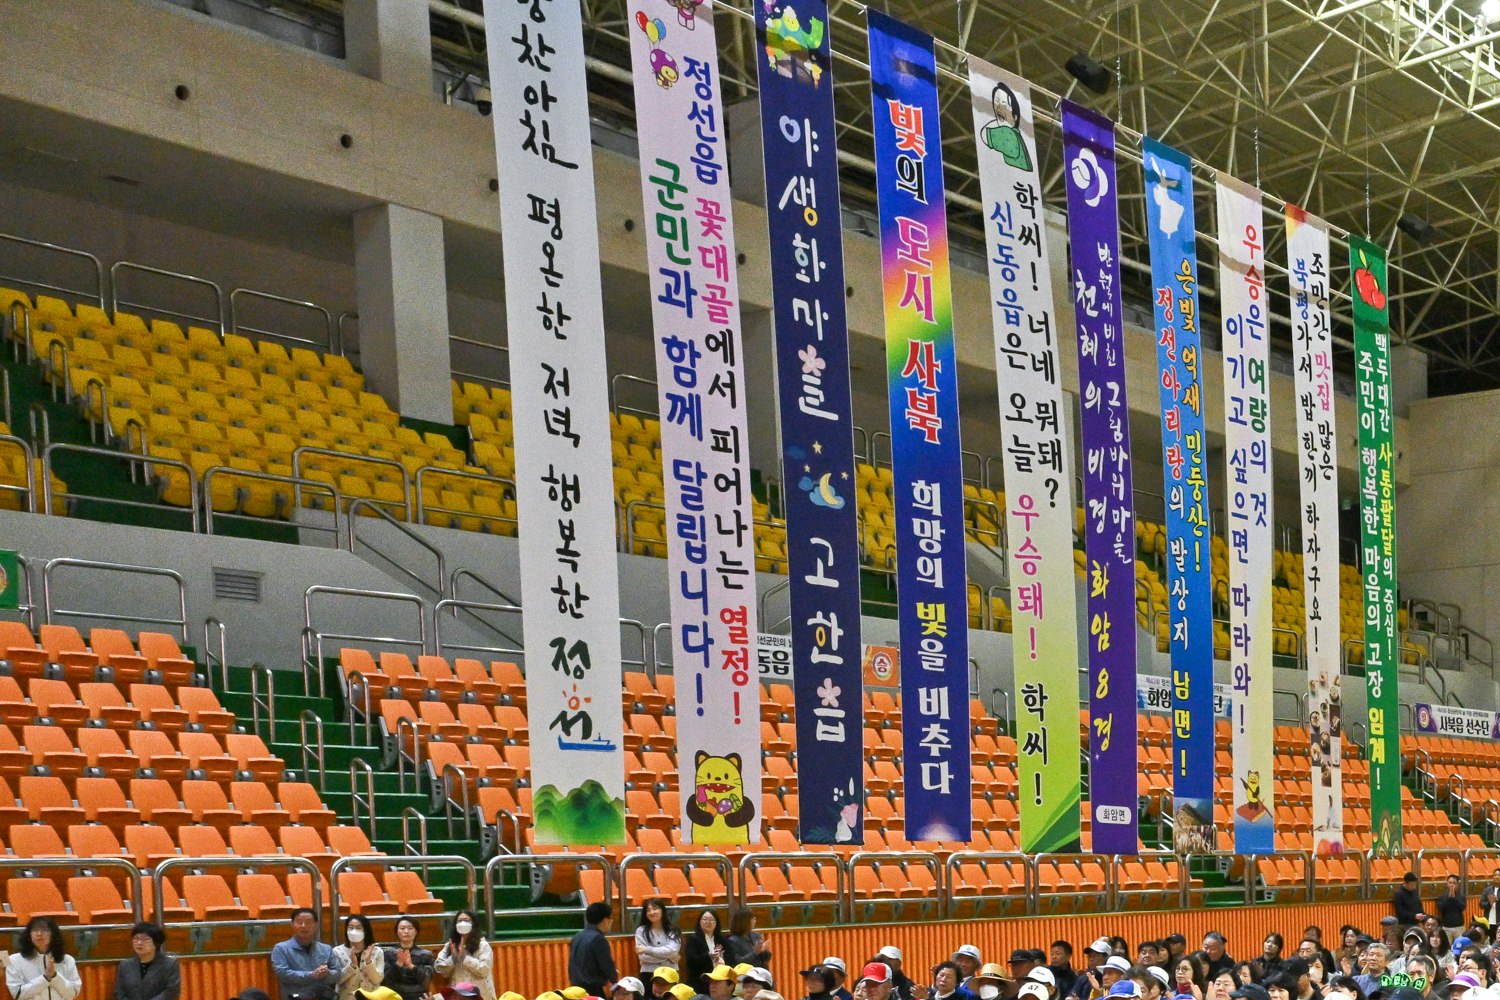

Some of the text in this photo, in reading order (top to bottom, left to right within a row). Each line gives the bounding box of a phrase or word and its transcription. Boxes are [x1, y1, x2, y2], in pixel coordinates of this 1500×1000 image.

[519, 80, 579, 169] 아침
[526, 193, 571, 341] 평온한
[1013, 181, 1063, 508] 학씨! 너네 뭐돼?
[1075, 269, 1101, 414] 천혜의
[540, 362, 582, 448] 저녁
[649, 158, 714, 717] 군민과 함께 달립니다!
[683, 56, 750, 725] 정선읍 꽃대골에서 피어나는 열정!
[887, 98, 955, 795] 빛의 도시 사북 희망의 빛을 비추다
[1156, 286, 1184, 520] 정선아리랑의
[1175, 259, 1208, 572] 은빛 억새 민둥산!
[1243, 224, 1267, 528] 우승은 여량의 것
[1314, 350, 1331, 412] 맛집
[1318, 420, 1334, 481] 많은
[990, 200, 1049, 807] 신동읍은 오늘 우승돼! 학씨!
[1087, 446, 1107, 534] 비경
[1226, 313, 1252, 734] 이기고 싶으면 따라와!
[1293, 258, 1313, 382] 북평가서
[1305, 502, 1322, 653] 하자구요!
[1375, 333, 1396, 660] 백두대간 사통팔달의 중심!
[541, 464, 589, 619] 행복한
[1169, 537, 1189, 651] 발상지
[1358, 351, 1386, 790] 주민이 행복한 마음의 고장 임계!
[549, 636, 617, 751] 정선
[757, 635, 786, 647] 선군민의
[804, 538, 845, 743] 고한읍
[876, 658, 888, 673] 승
[1440, 716, 1489, 736] 사북읍 선수단
[1102, 808, 1125, 822] 화암면
